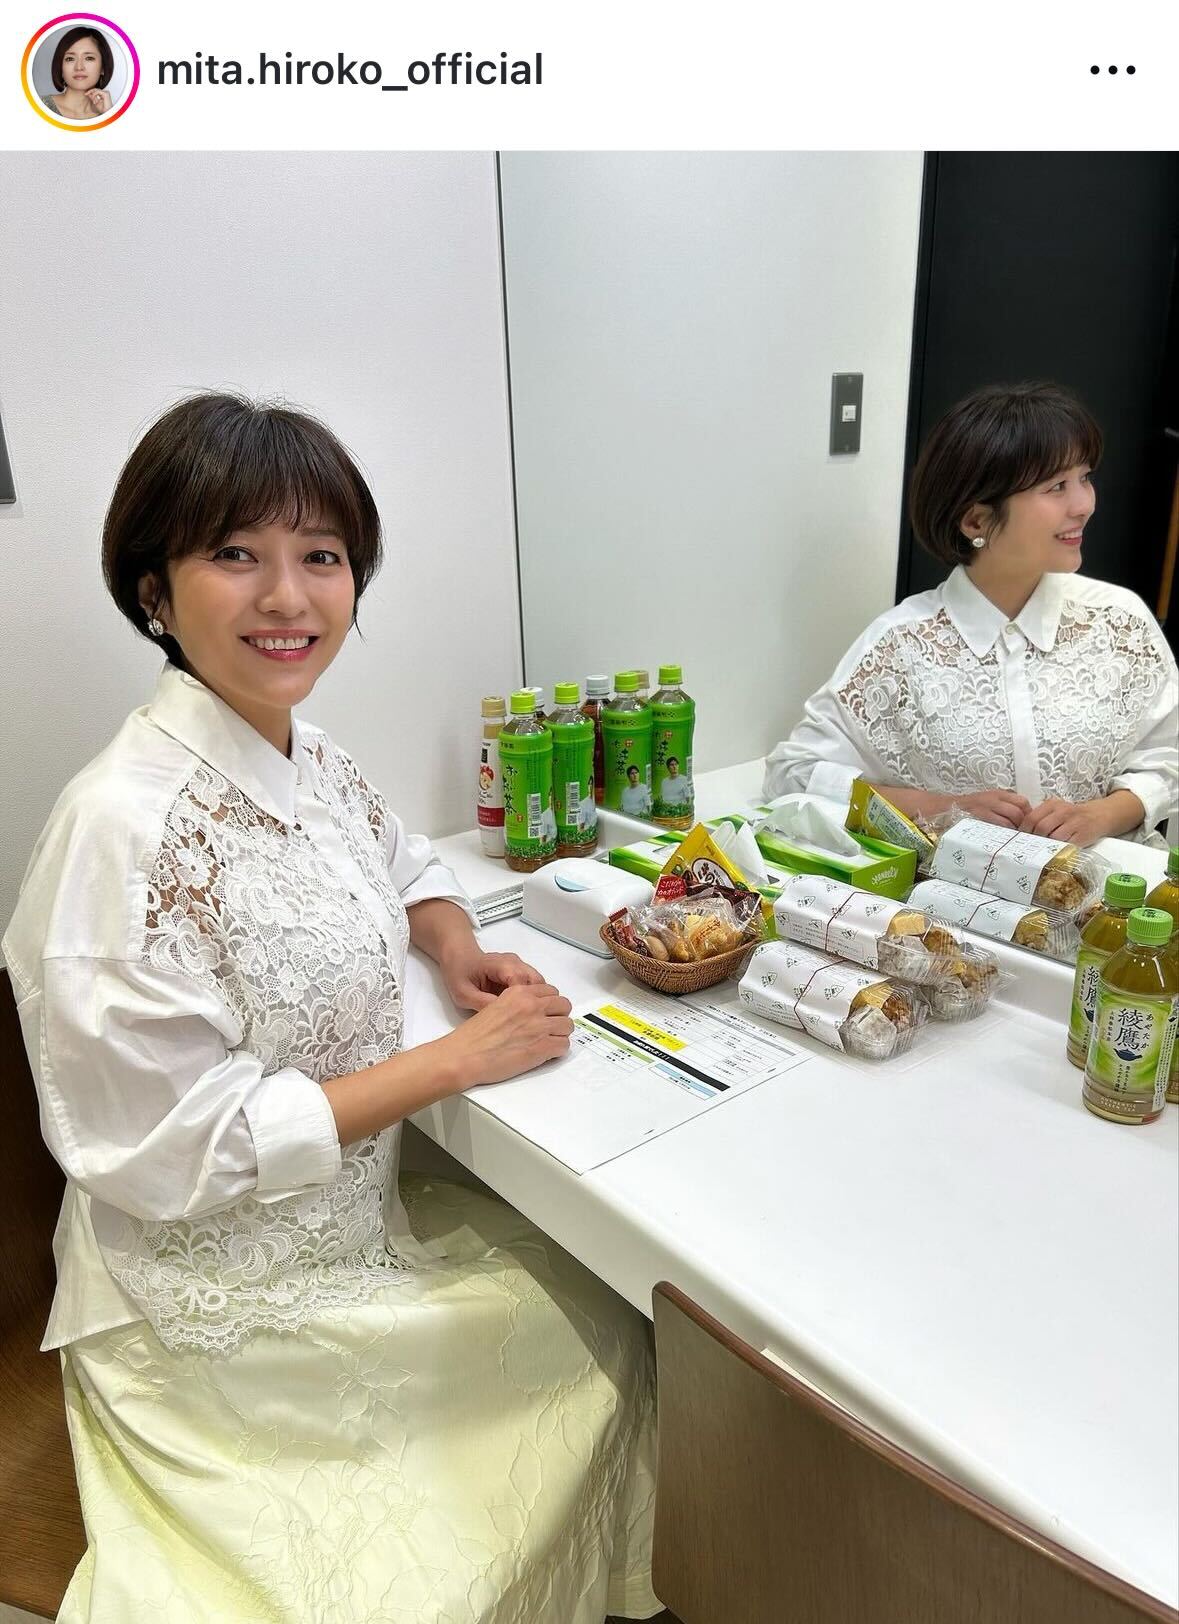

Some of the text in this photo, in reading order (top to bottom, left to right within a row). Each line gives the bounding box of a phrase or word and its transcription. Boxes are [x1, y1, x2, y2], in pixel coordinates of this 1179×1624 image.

[1114, 1008, 1144, 1050] 綾鷹
[1141, 1013, 1154, 1049] あやたか
